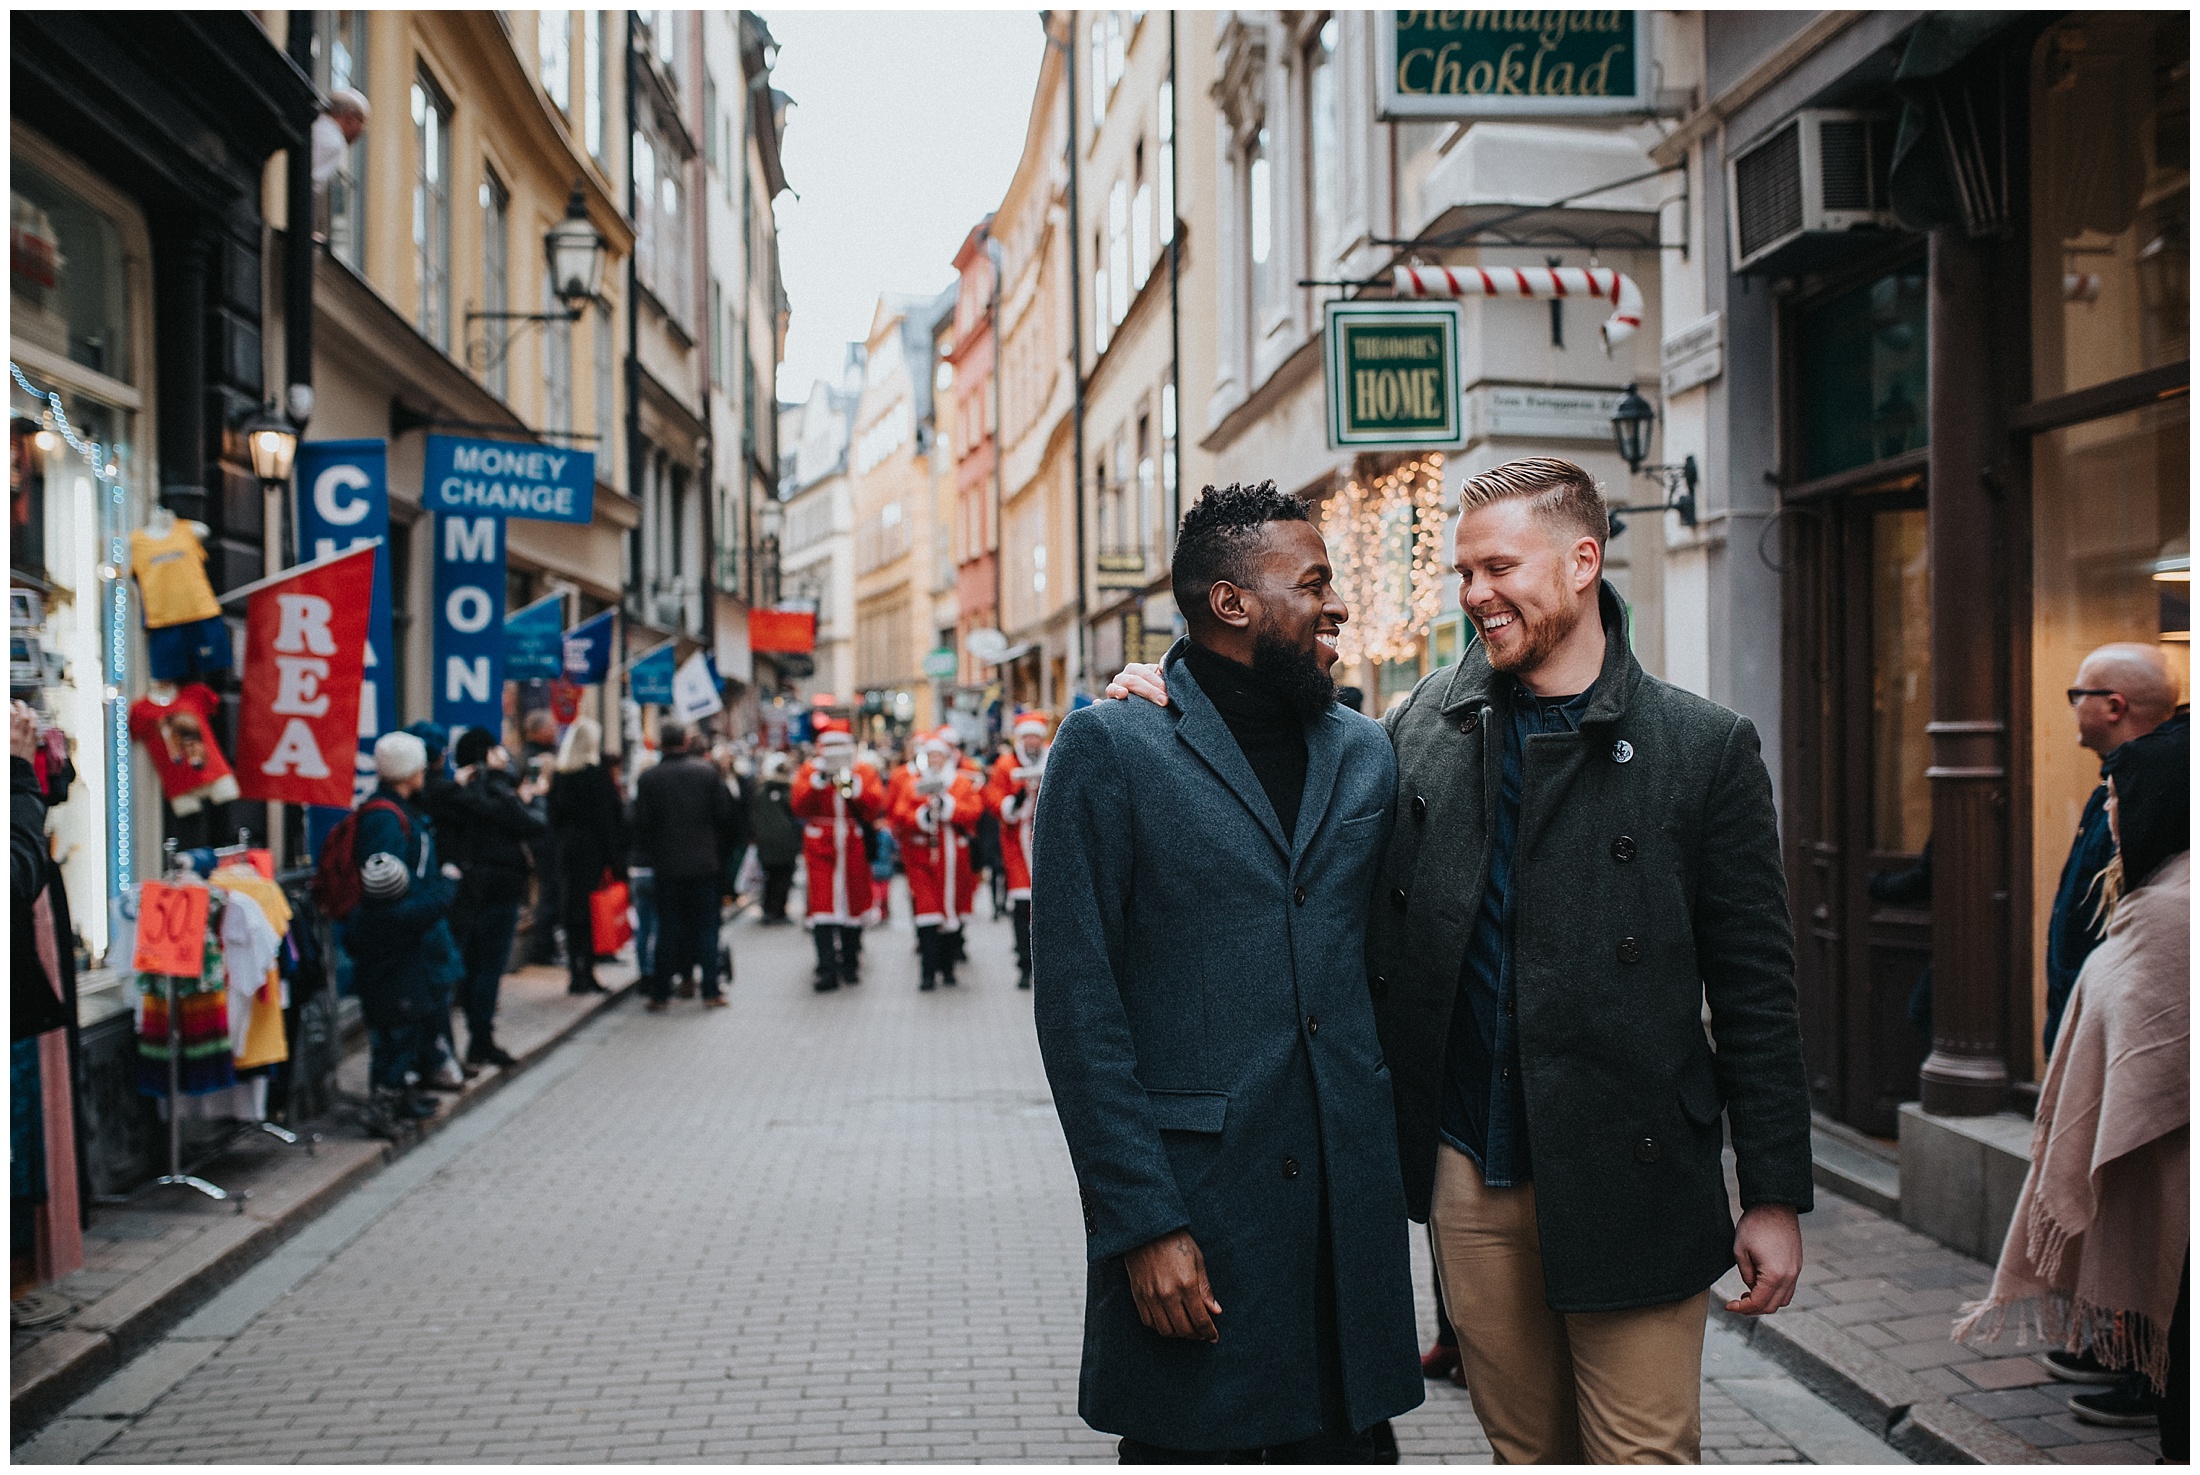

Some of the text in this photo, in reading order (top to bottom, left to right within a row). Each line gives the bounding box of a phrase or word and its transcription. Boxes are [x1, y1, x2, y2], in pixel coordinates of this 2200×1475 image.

[1398, 42, 1625, 95] Choklad
[1355, 368, 1441, 420] HOME
[453, 446, 567, 480] MONEY
[441, 477, 574, 514] CHANGE
[444, 516, 497, 755] MON
[261, 594, 337, 778] REA
